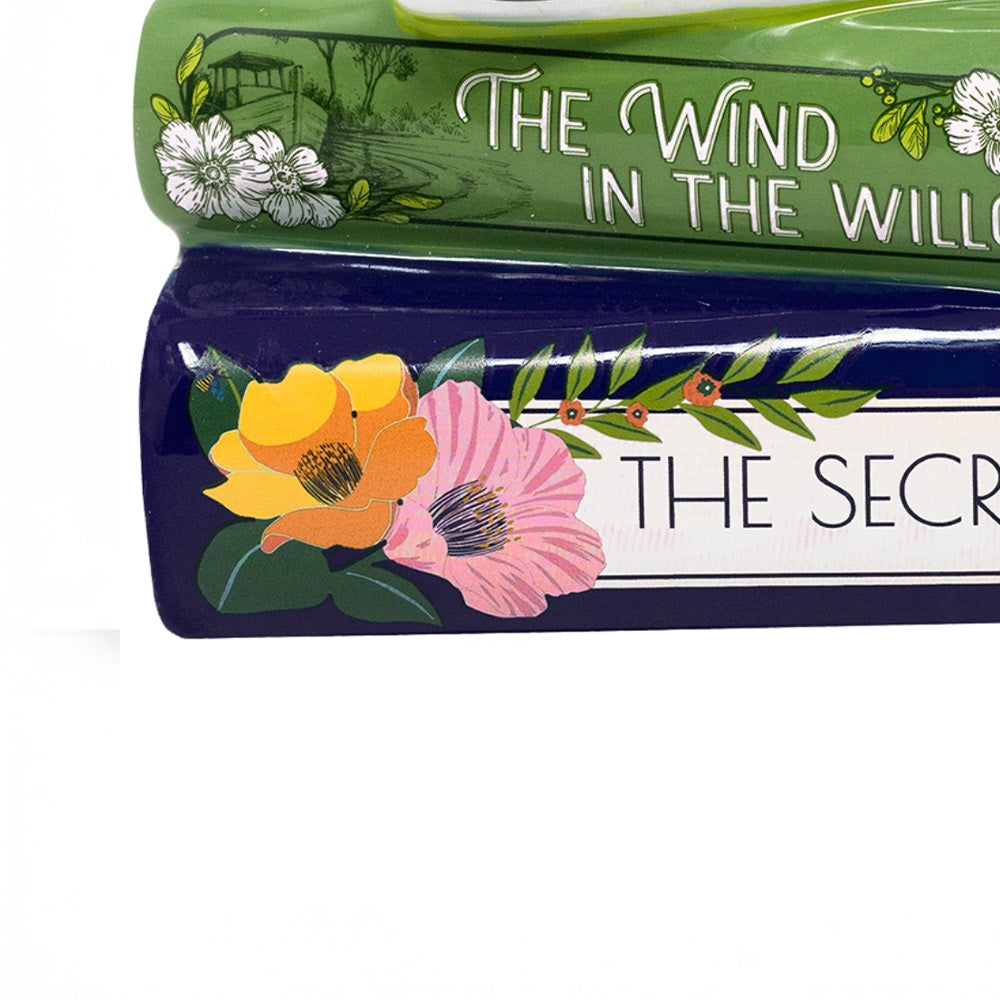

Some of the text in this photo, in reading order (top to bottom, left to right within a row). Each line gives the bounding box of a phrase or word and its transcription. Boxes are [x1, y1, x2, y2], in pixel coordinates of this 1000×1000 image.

[455, 65, 838, 171] THE WIND
[580, 165, 643, 226] IN
[672, 171, 803, 238] THE
[620, 454, 773, 530] THE
